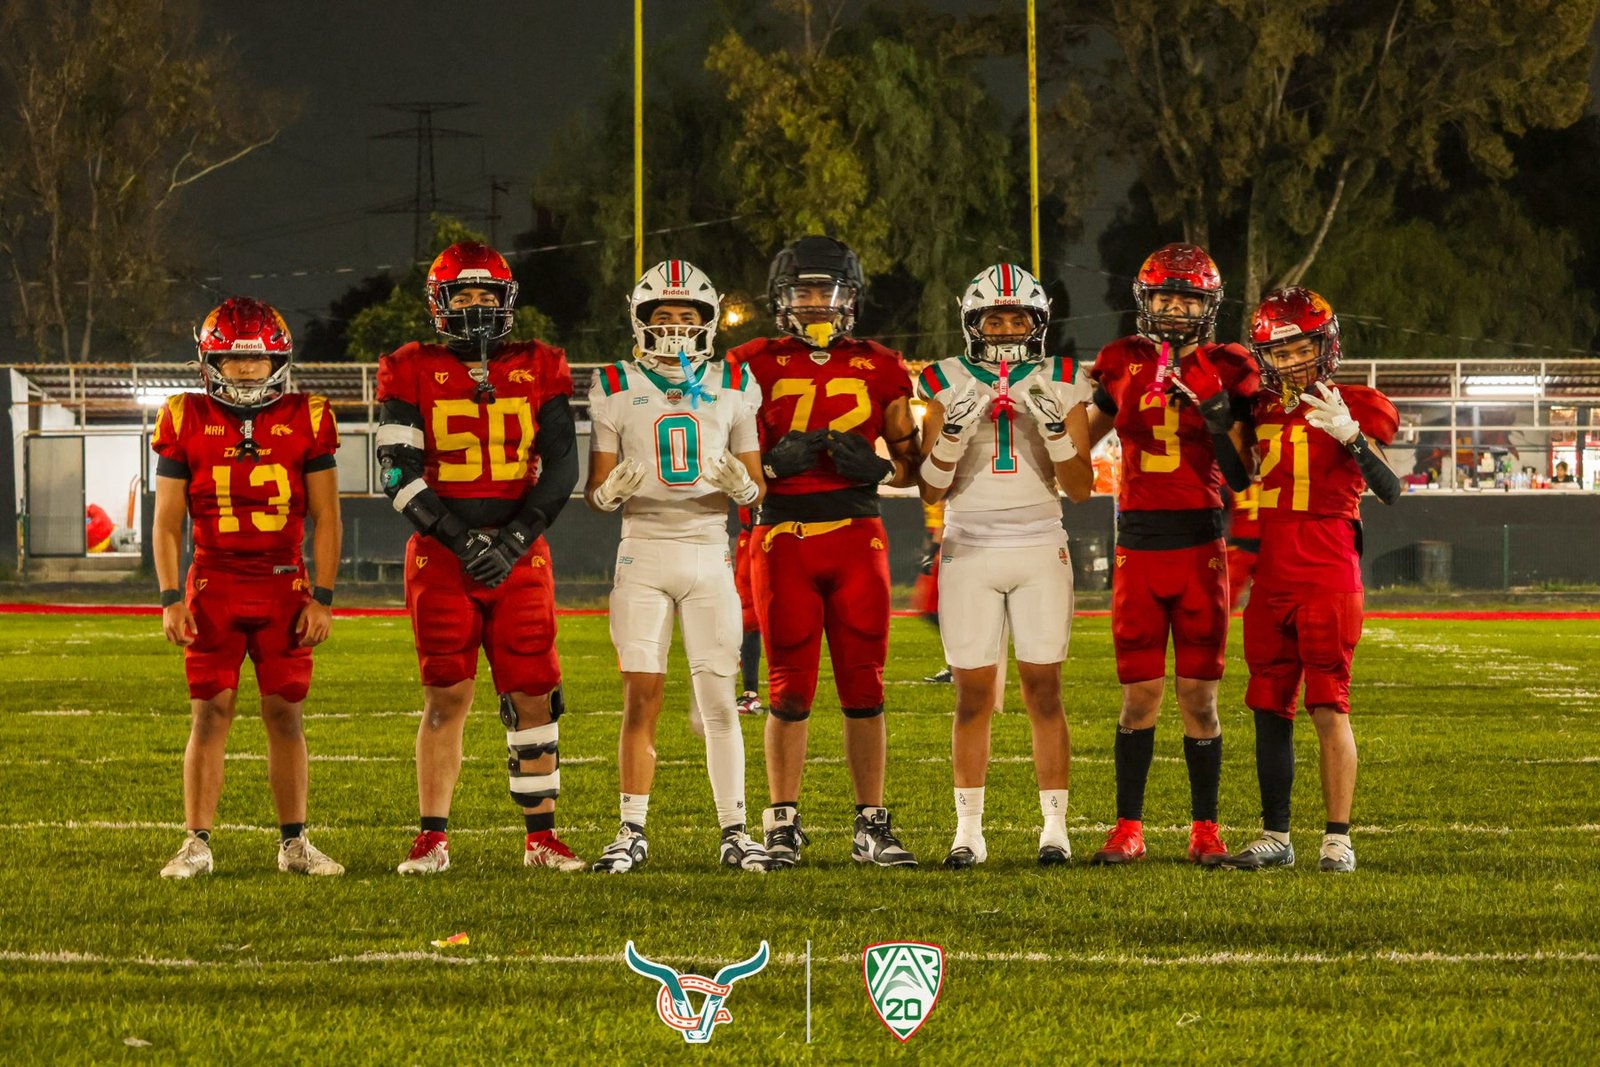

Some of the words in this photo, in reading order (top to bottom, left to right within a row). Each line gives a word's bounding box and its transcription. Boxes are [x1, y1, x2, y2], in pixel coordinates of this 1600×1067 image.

[204, 424, 225, 436] MRH
[431, 396, 535, 482] 50
[771, 377, 872, 434] 72
[991, 408, 1018, 474] 1
[1139, 394, 1182, 473] 3
[653, 412, 702, 487] 0
[1255, 423, 1311, 512] 21
[212, 463, 292, 533] 13
